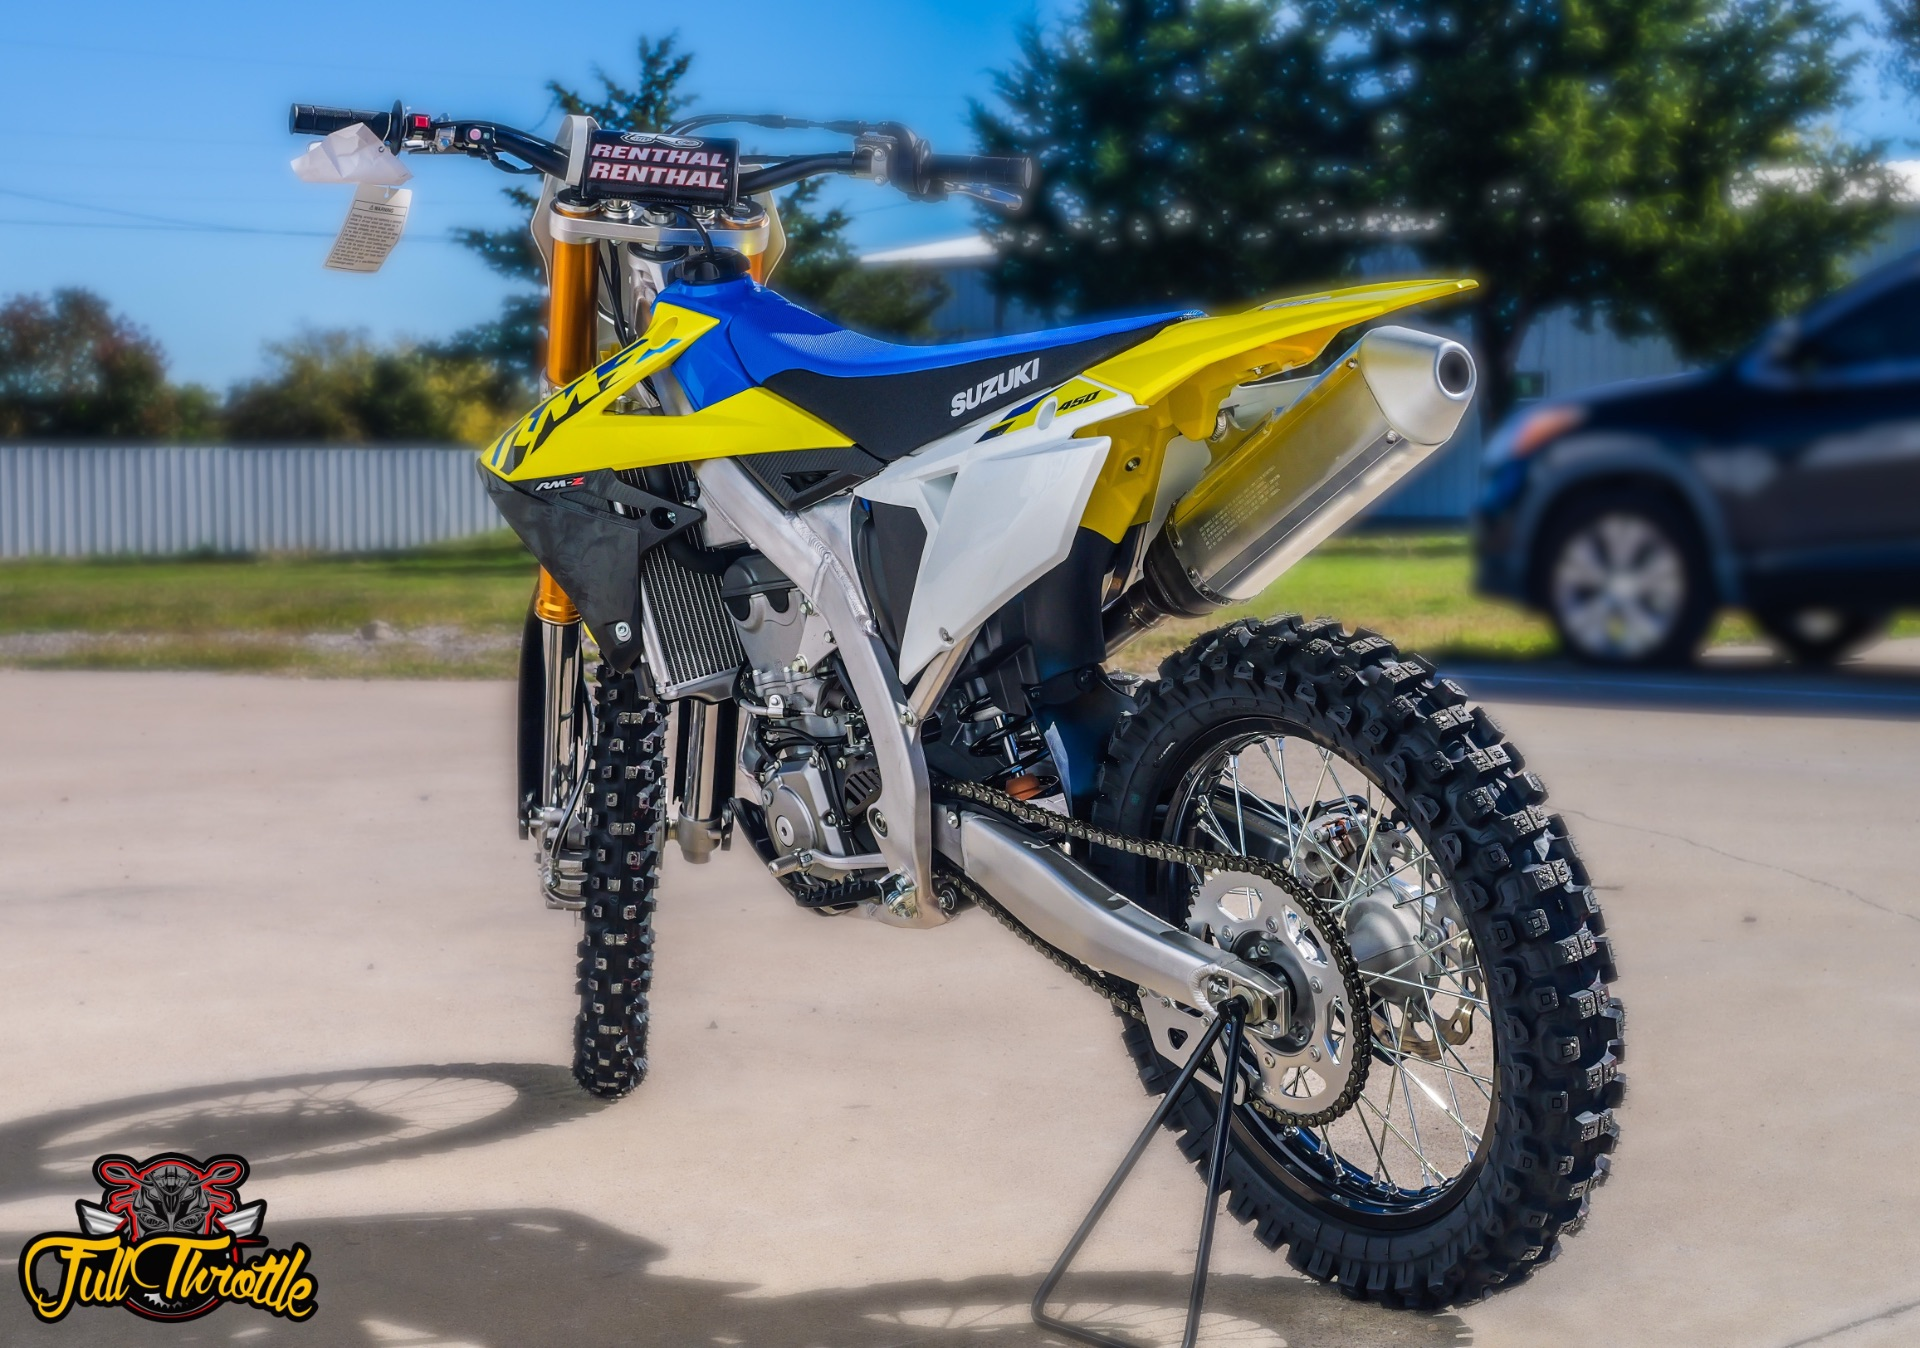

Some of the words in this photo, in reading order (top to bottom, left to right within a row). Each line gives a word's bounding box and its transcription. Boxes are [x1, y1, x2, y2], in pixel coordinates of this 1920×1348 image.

[591, 143, 727, 168] RENTHAL
[589, 162, 726, 189] RENTHAL
[950, 357, 1040, 418] SUZUKI
[1057, 389, 1102, 412] 450
[534, 476, 585, 492] RM-Z
